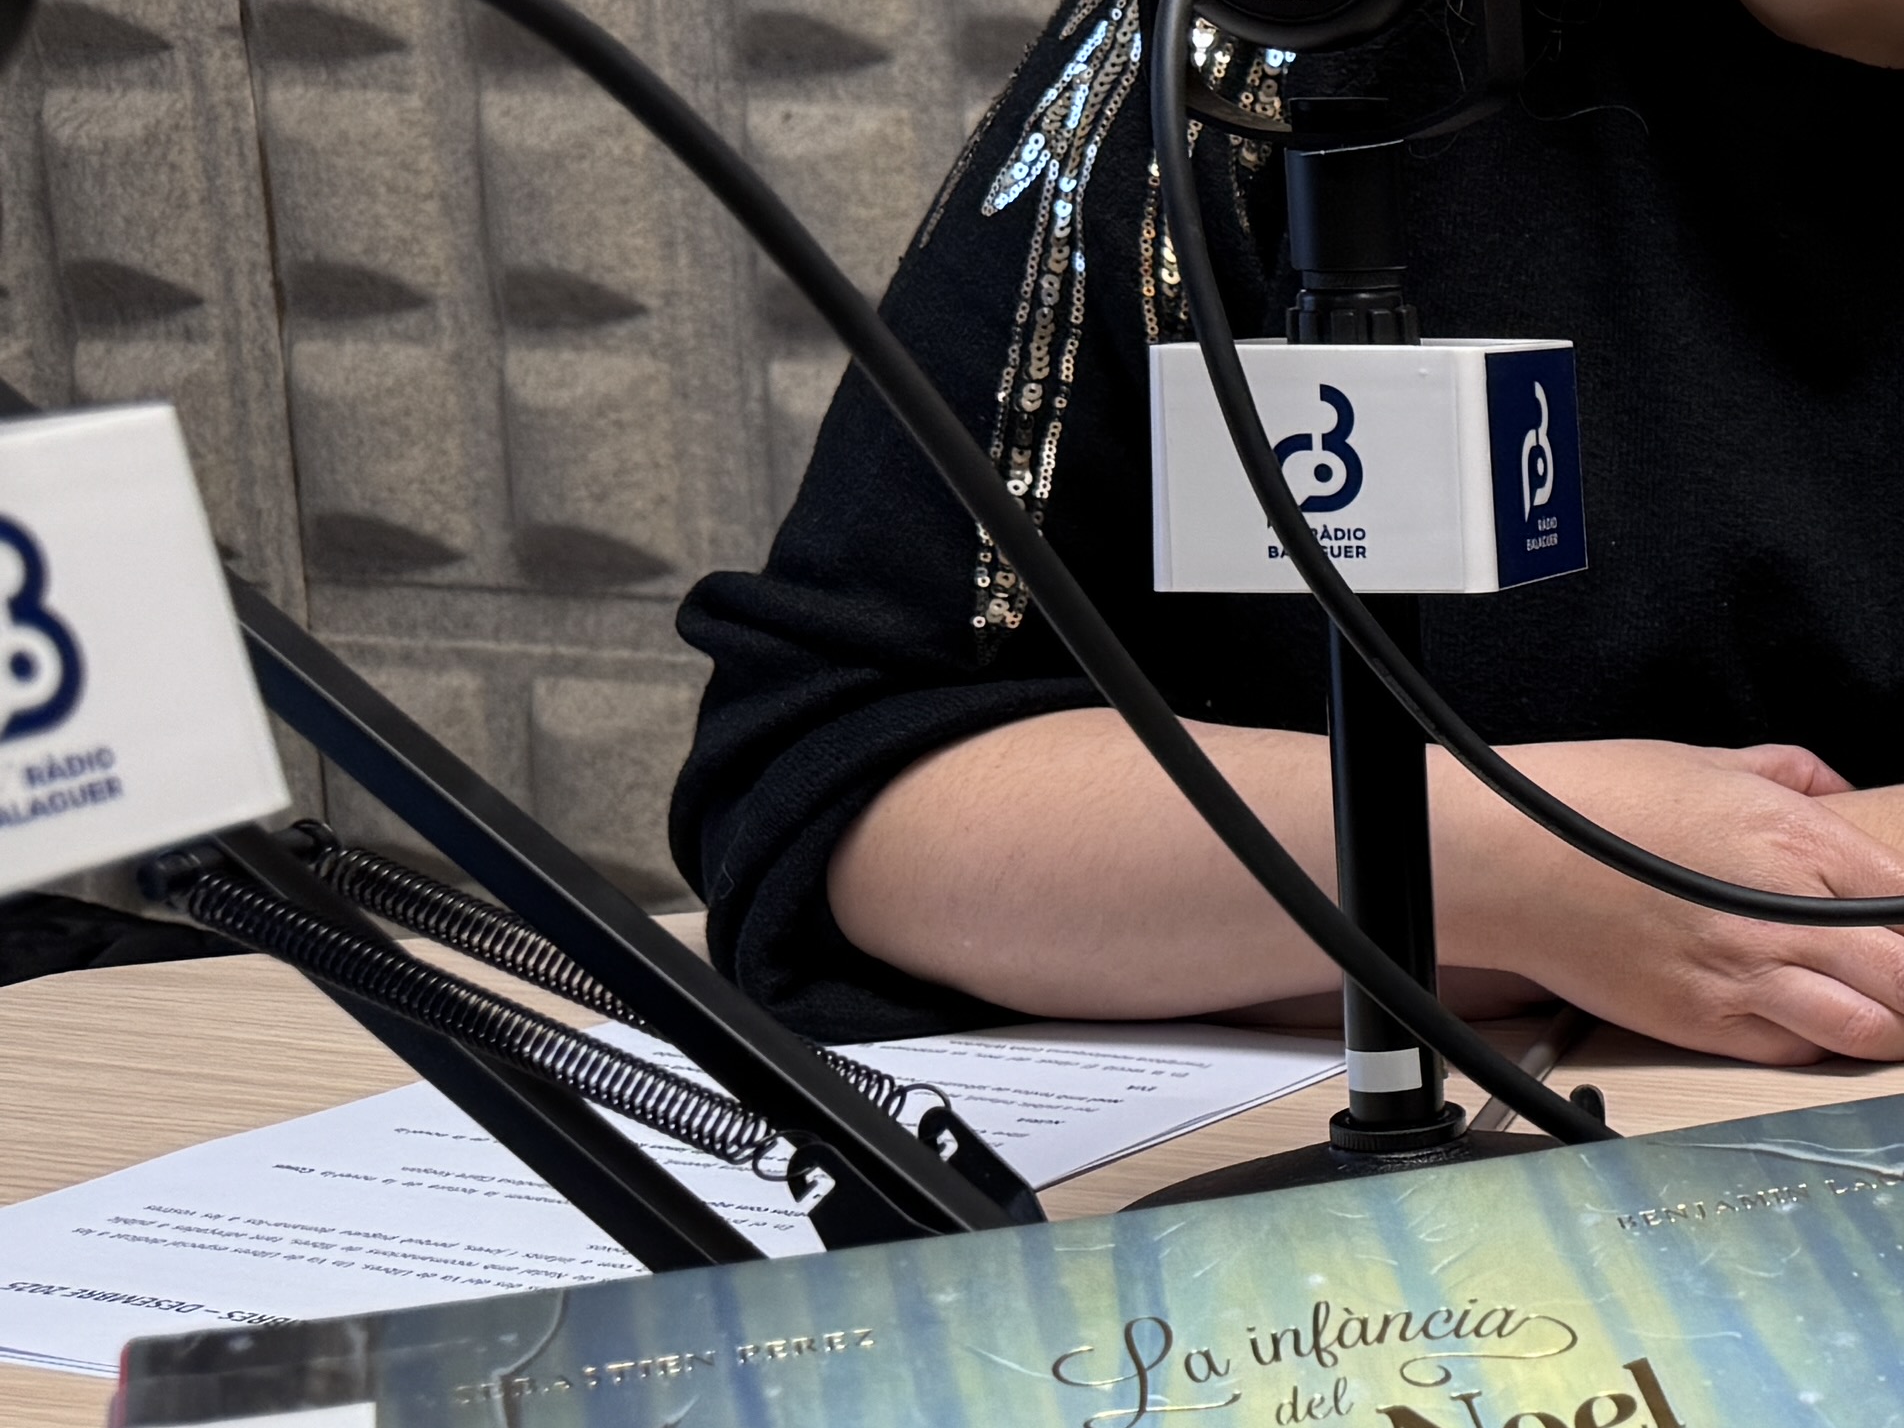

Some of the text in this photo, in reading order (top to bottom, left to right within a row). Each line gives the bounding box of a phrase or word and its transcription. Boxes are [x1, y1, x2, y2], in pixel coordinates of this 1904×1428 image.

[0, 1281, 70, 1294] 2025
[58, 1288, 205, 1313] DESEMBRE
[736, 1327, 876, 1364] PEREZ
[1244, 1296, 1580, 1389] infància
[1274, 1376, 1356, 1428] del
